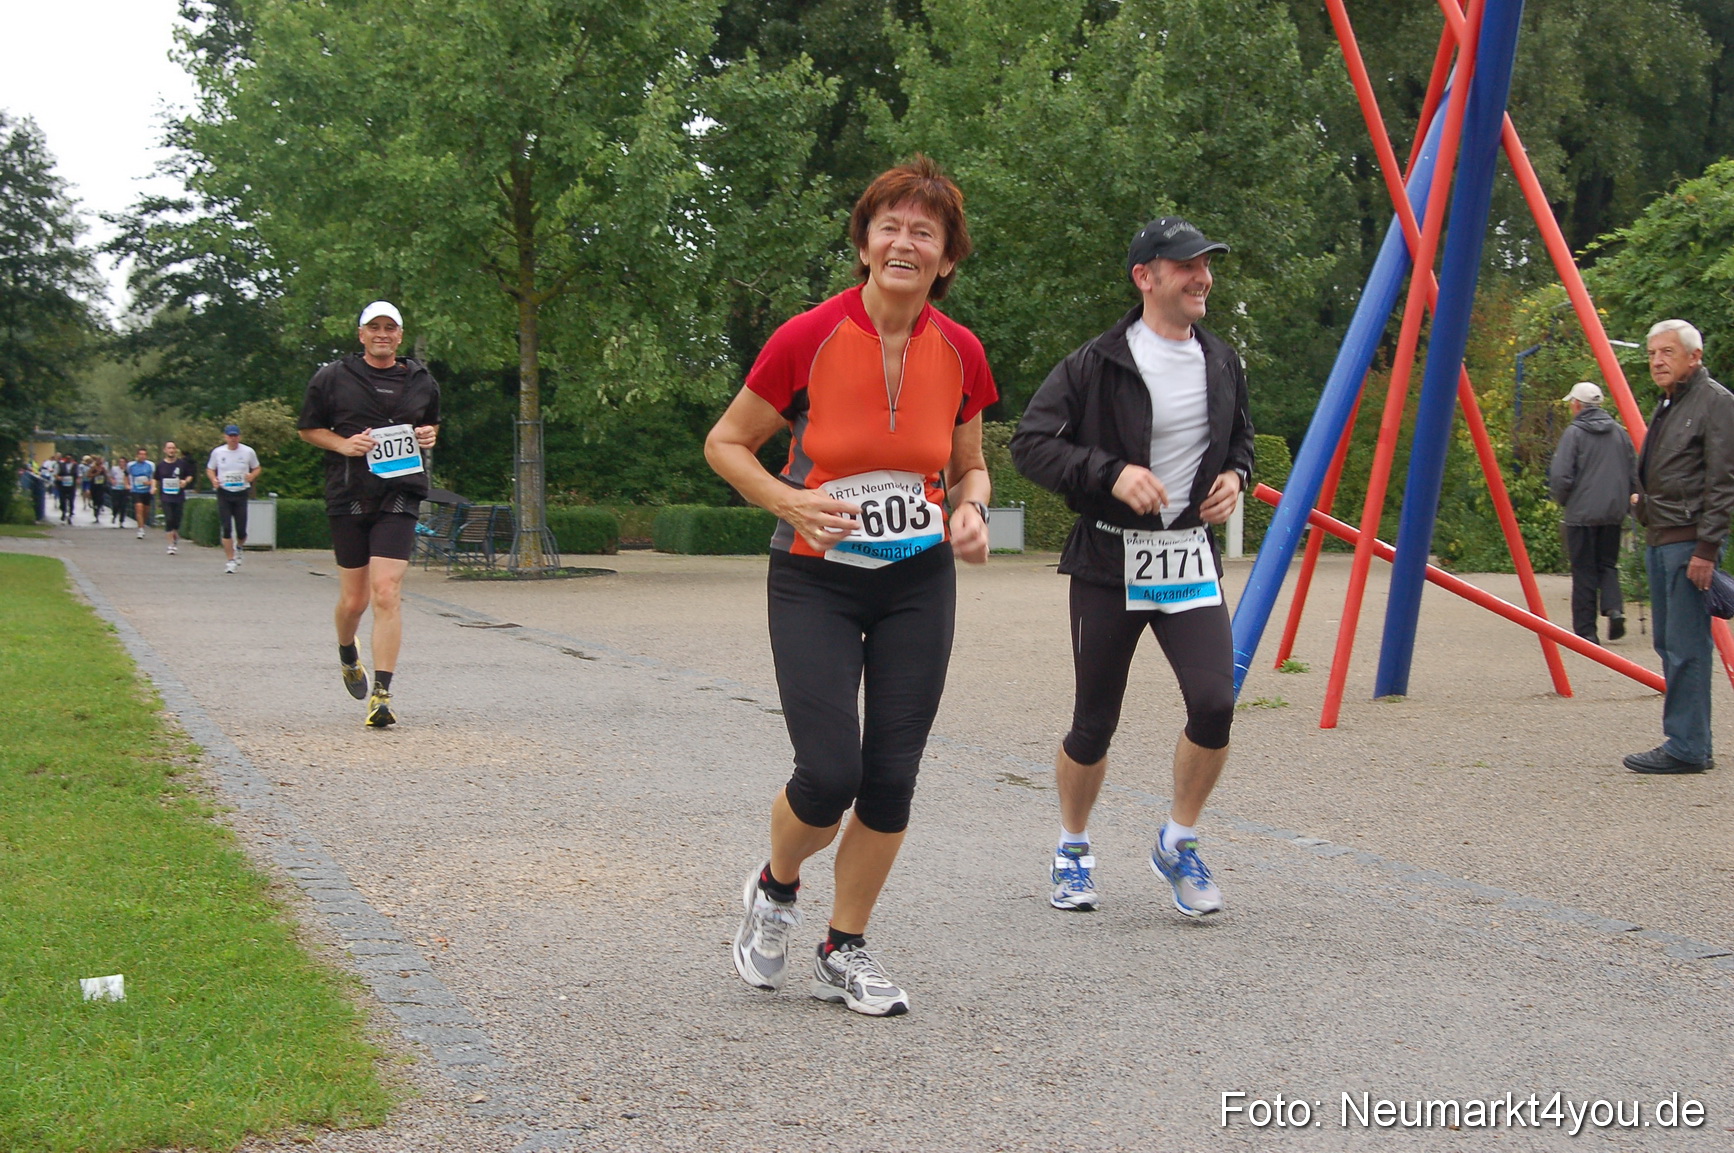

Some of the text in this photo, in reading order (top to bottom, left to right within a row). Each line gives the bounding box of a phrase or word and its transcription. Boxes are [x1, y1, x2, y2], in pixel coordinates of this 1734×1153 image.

[373, 436, 414, 460] 3073
[829, 487, 860, 501] ARTL
[839, 495, 931, 538] 603
[851, 543, 922, 559] Rosmarie
[1135, 548, 1204, 580] 2171
[1143, 587, 1202, 601] Alexander
